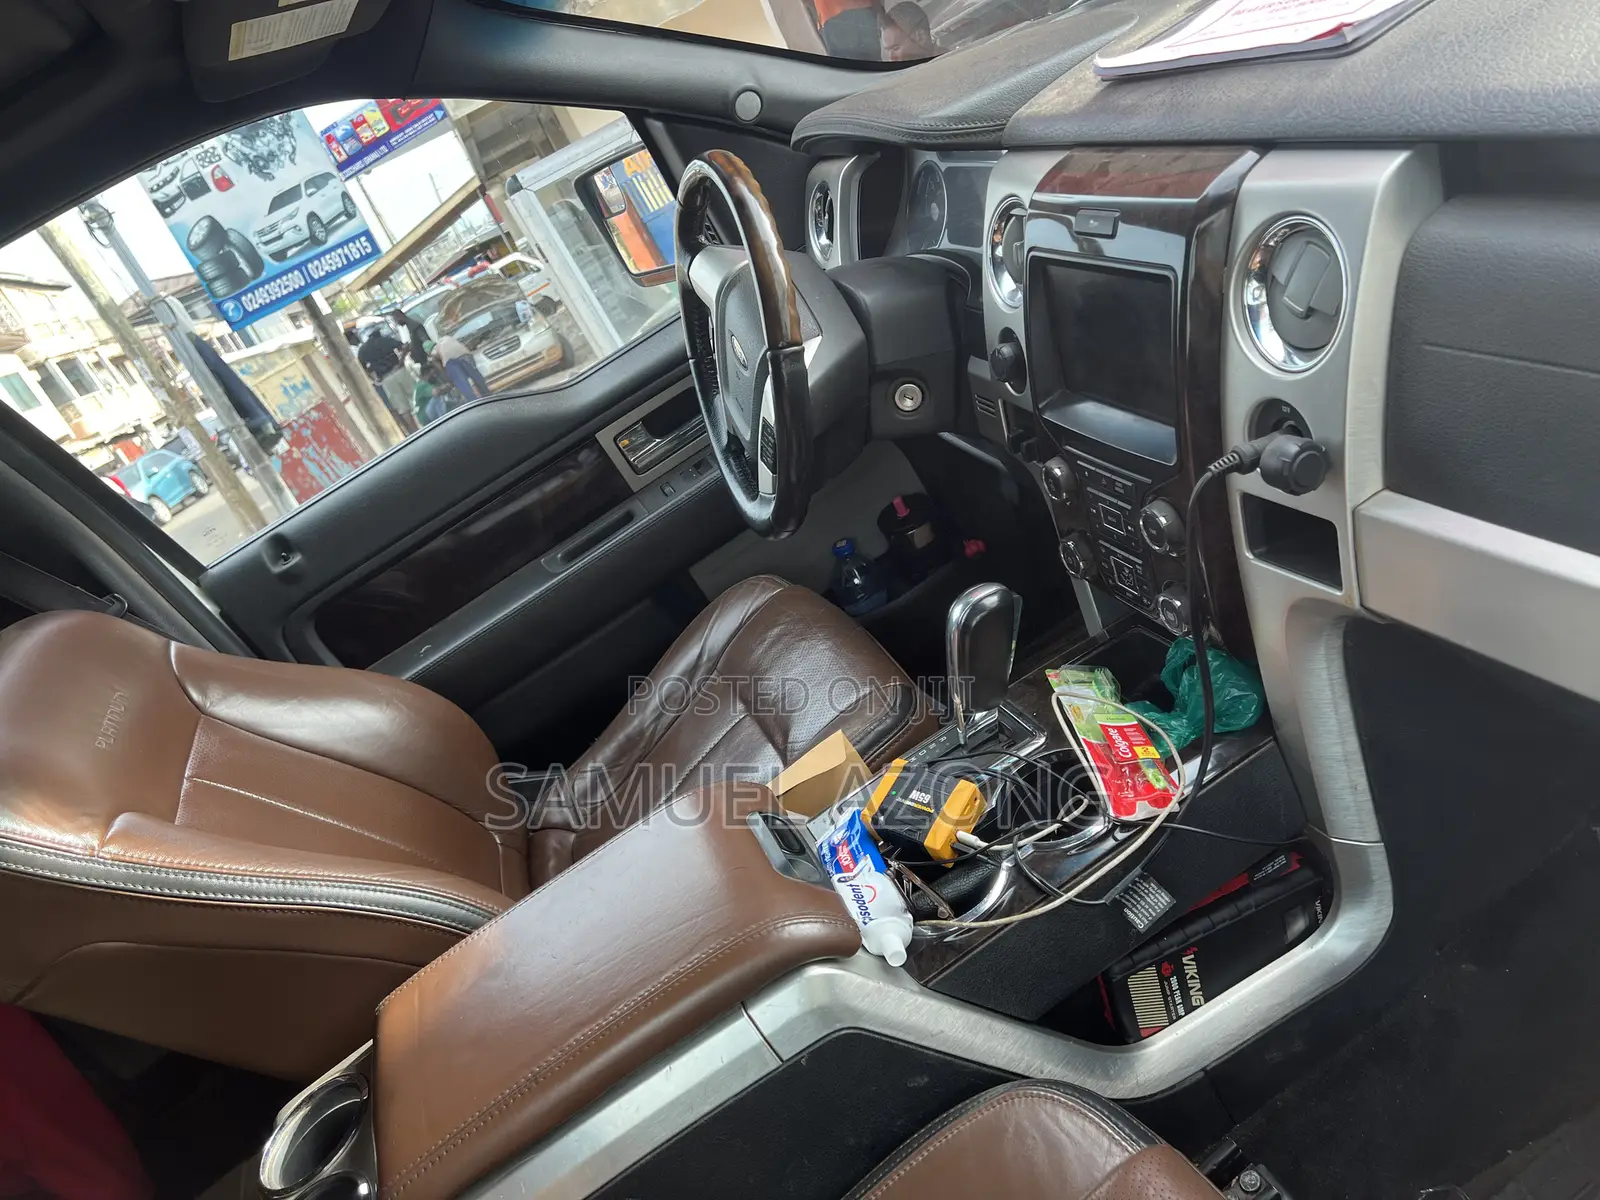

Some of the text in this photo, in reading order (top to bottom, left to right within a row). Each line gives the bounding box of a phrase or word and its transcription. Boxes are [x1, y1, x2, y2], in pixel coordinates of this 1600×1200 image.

[242, 270, 305, 312] 0249392500
[308, 235, 373, 280] 0245971815
[94, 691, 130, 750] PLATINUM
[1107, 727, 1132, 758] Colgate
[908, 789, 931, 804] 65W
[1123, 907, 1144, 929] Caution
[1314, 899, 1325, 925] VIKIN
[1181, 953, 1205, 1007] VIKING
[1167, 996, 1177, 1020] STARTER
